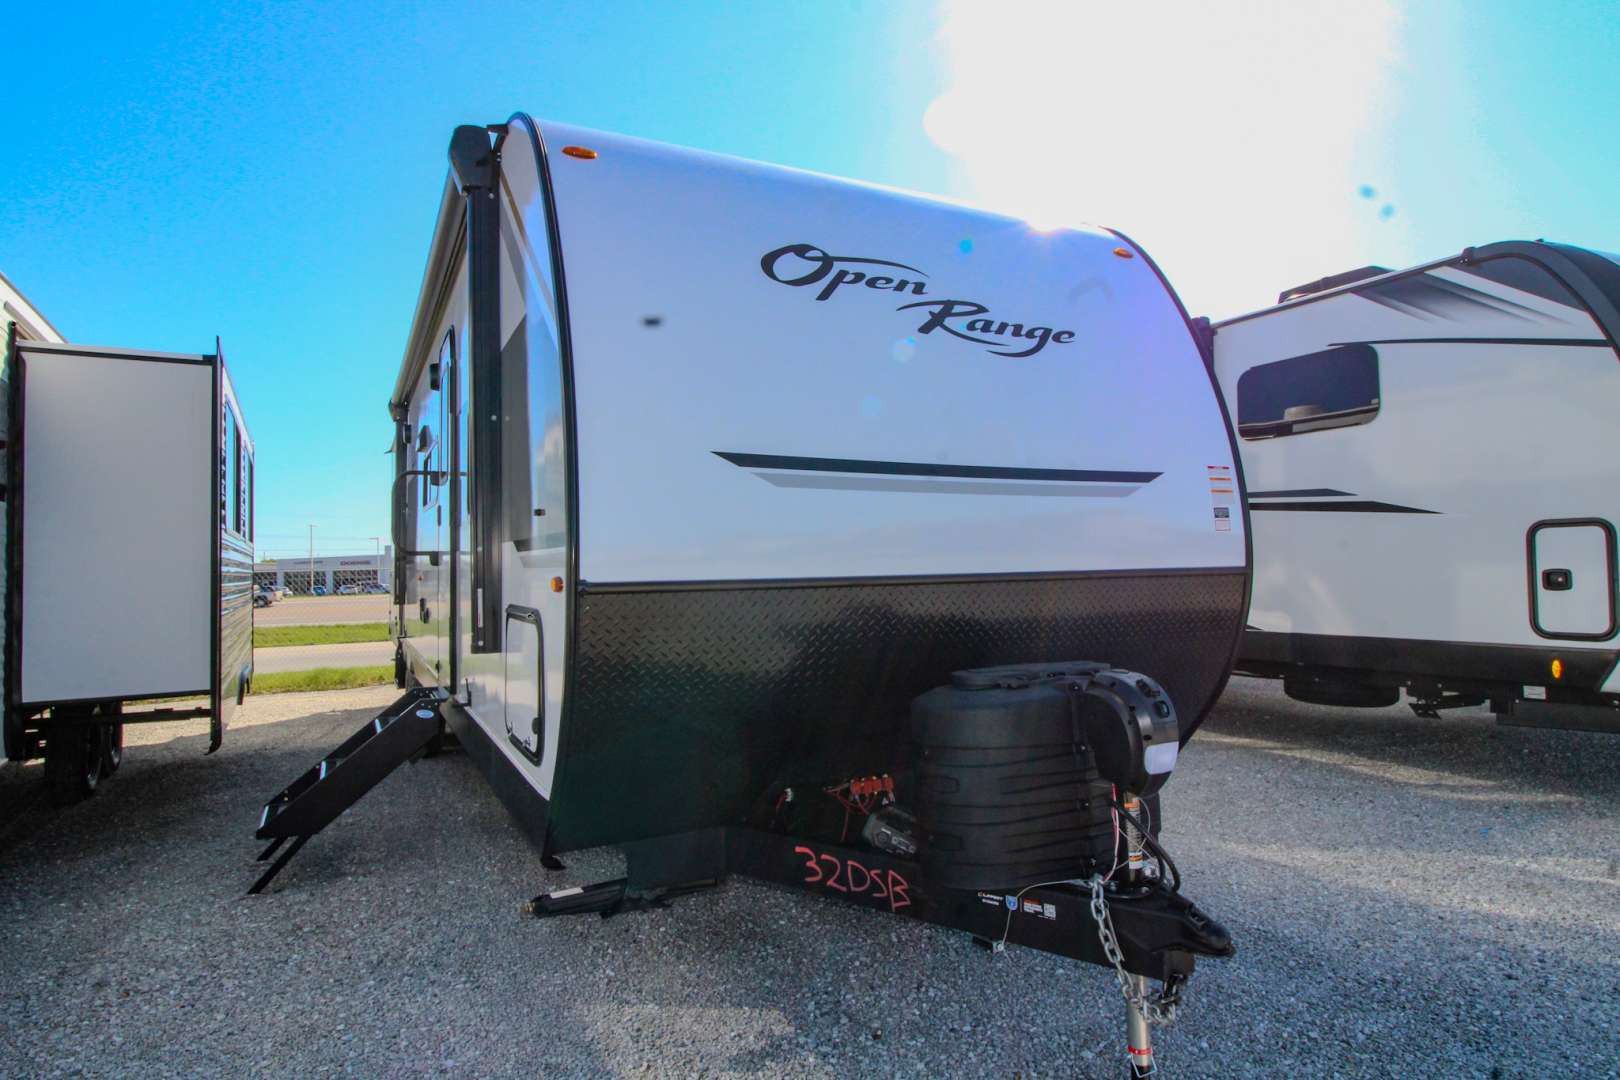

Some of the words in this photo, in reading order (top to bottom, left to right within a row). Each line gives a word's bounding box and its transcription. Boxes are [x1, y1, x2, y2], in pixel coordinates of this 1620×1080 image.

[761, 243, 928, 301] Open
[896, 299, 1076, 358] Range
[794, 846, 911, 912] 32DSB
